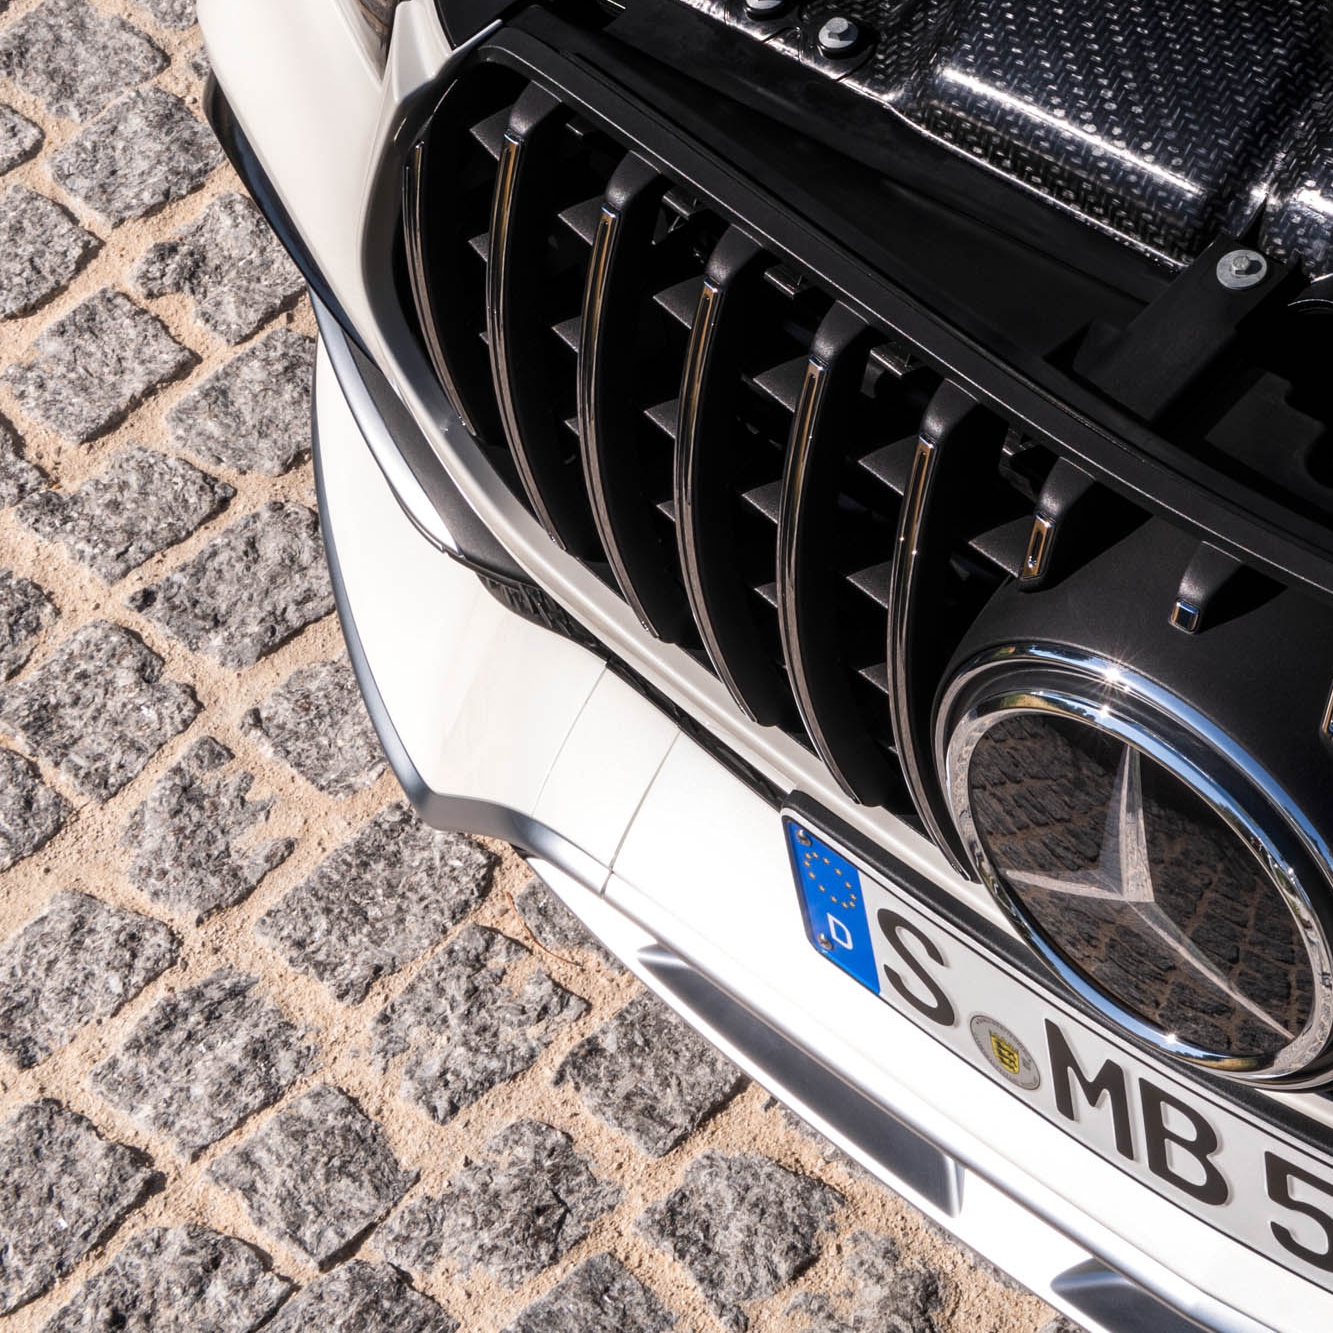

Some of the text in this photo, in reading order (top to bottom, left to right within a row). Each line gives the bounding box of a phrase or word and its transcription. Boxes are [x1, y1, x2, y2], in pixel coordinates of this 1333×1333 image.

[831, 913, 855, 951] D
[876, 906, 957, 1030] S
[1044, 1016, 1232, 1209] MB
